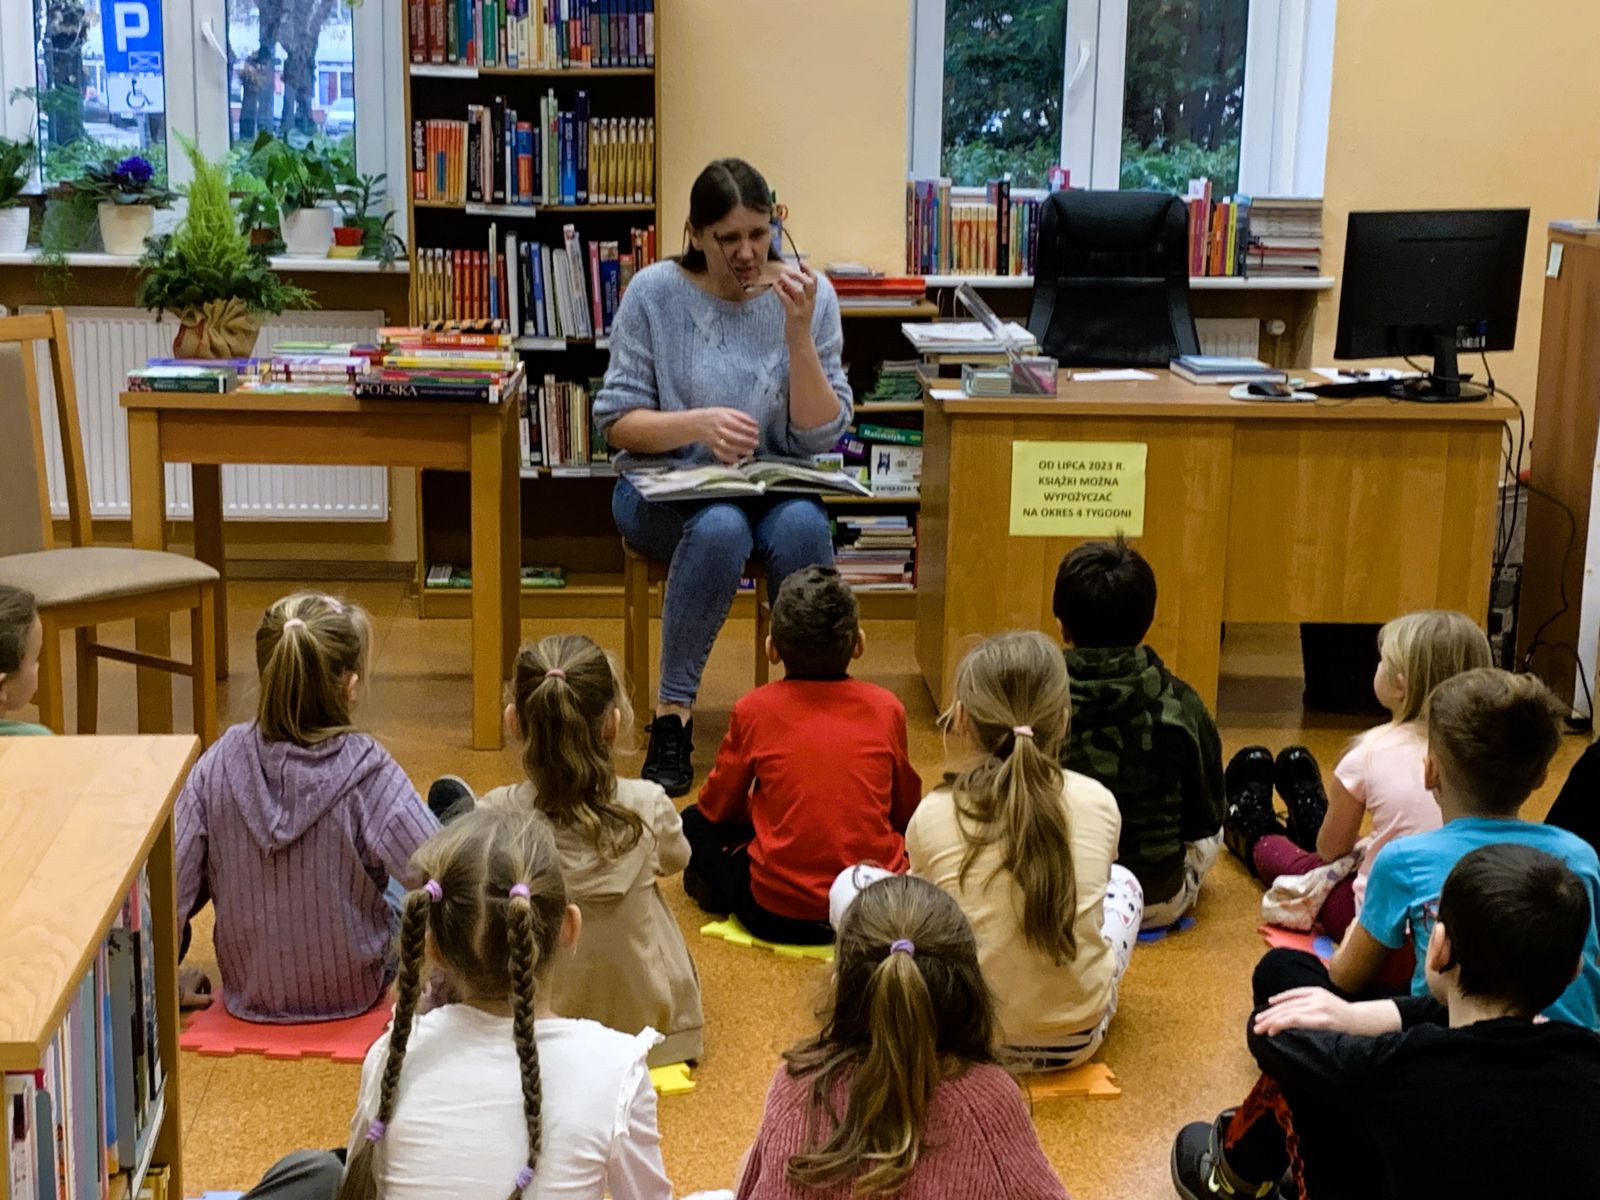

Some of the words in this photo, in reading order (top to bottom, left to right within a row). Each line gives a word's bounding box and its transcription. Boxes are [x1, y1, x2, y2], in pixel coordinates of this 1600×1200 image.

[113, 2, 150, 53] P
[359, 383, 418, 397] POLSKA
[1038, 460, 1055, 470] OD
[1057, 460, 1086, 471] LIPCA
[1088, 461, 1113, 471] 2023
[1115, 461, 1126, 471] R.
[1038, 475, 1077, 488] KSIĄŻKI
[1079, 476, 1119, 486] MOŻNA
[1043, 491, 1112, 502] WYPOŻYCZAĆ
[1022, 508, 1038, 517] NA
[1040, 508, 1074, 517] OKRES
[1076, 508, 1083, 517] 4
[1085, 508, 1132, 518] TYGODNI
